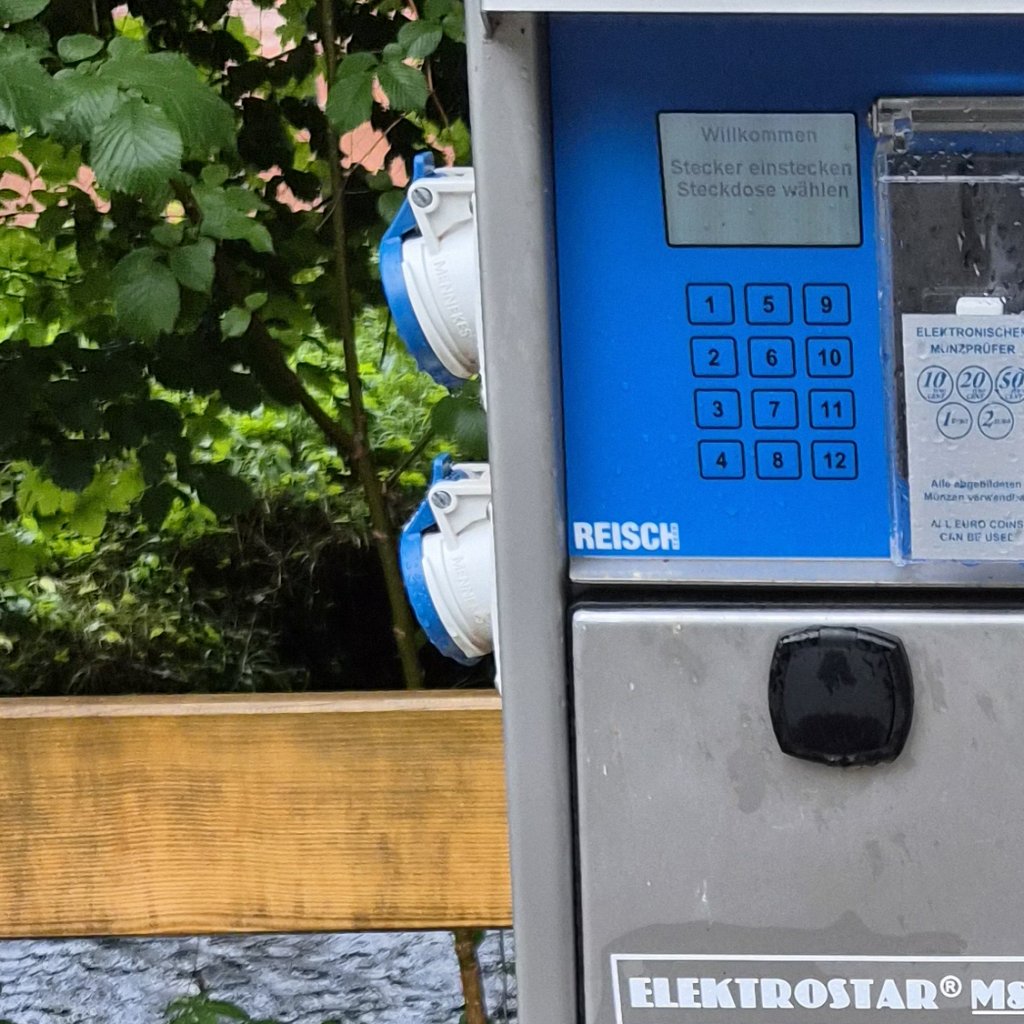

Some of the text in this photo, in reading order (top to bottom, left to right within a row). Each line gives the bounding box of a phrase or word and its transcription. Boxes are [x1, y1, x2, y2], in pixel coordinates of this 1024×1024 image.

[701, 126, 818, 143] Willkommen
[671, 159, 852, 177] Stecker einstecken
[677, 181, 849, 199] Steckdose wählen
[705, 296, 715, 314] 1
[763, 295, 774, 313] 5
[820, 295, 832, 314] 9
[708, 349, 720, 367] 2
[766, 349, 778, 367] 6
[818, 349, 841, 367] 10
[923, 371, 947, 388] 10
[960, 371, 986, 388] 20
[999, 371, 1024, 389] 50
[712, 401, 723, 418] 3
[769, 401, 780, 418] 7
[821, 400, 842, 418] 11
[943, 411, 951, 427] 1
[982, 410, 994, 428] 2
[716, 452, 728, 469] 4
[772, 452, 784, 469] 8
[823, 452, 846, 469] 12
[931, 479, 1022, 490] Alle abgebildeten
[924, 492, 965, 502] Münzen
[955, 519, 986, 529] EURO
[989, 519, 1024, 529] COINS
[573, 521, 680, 551] REISCH
[939, 532, 963, 542] CAN
